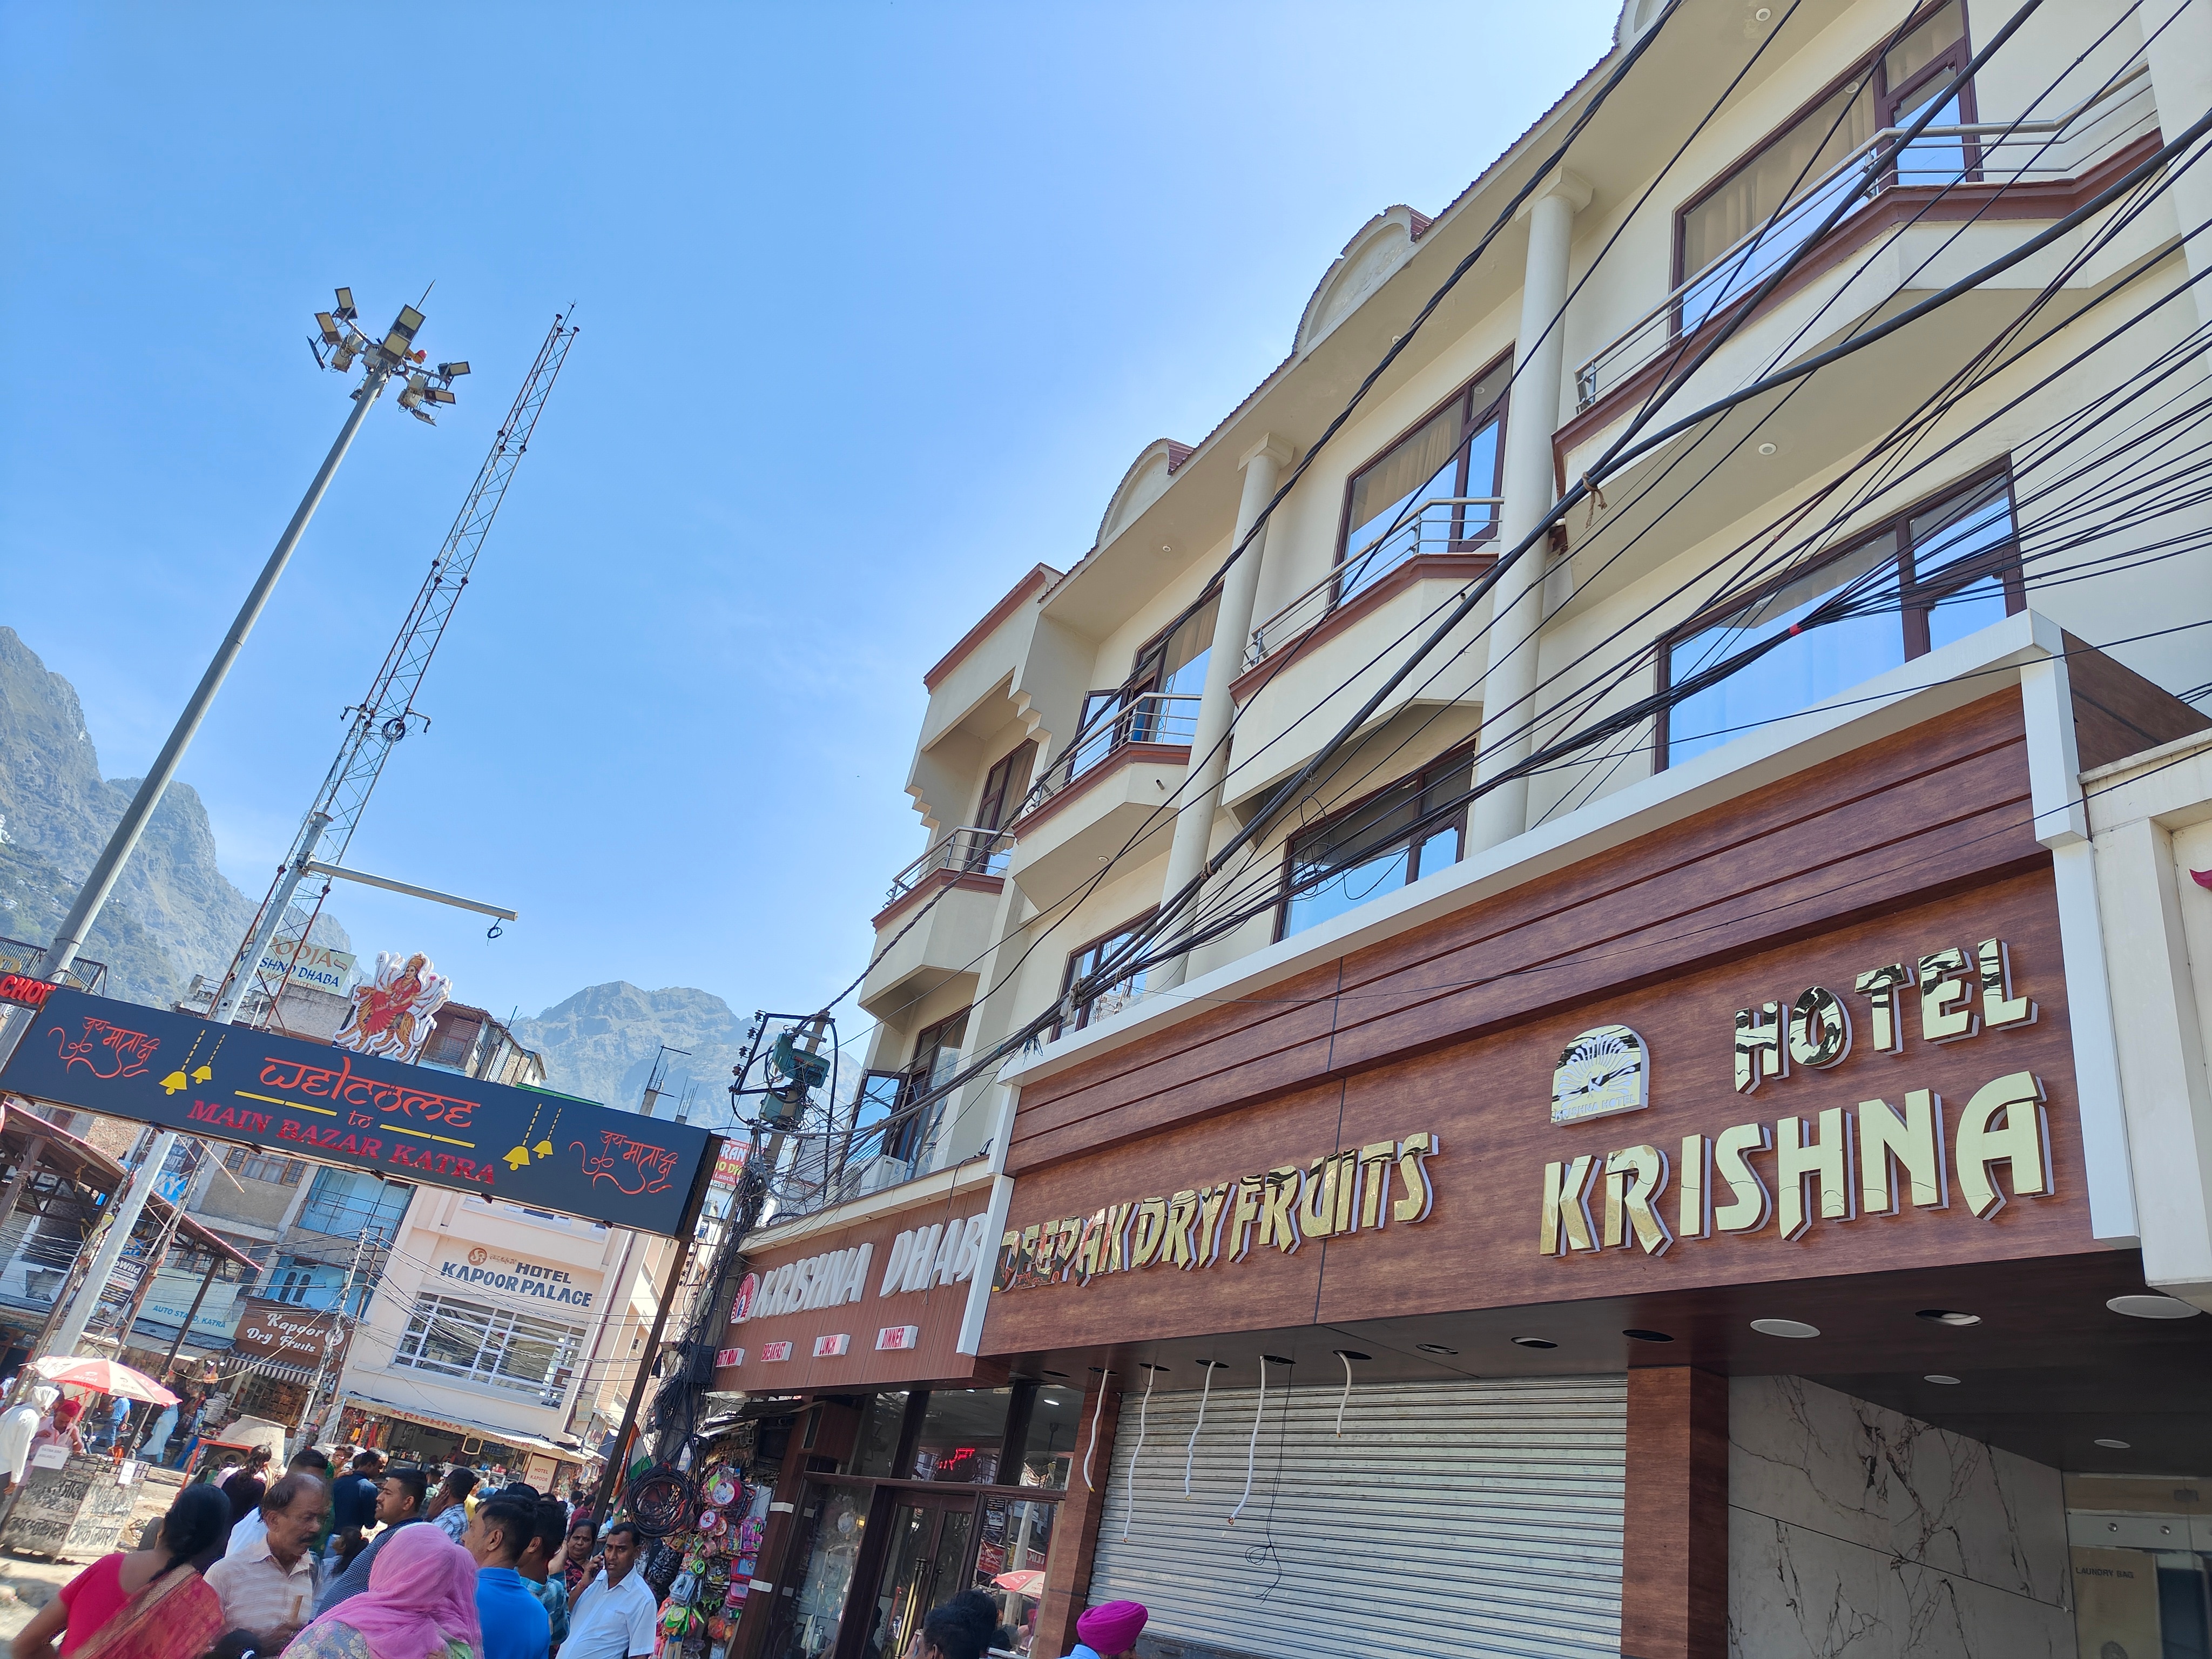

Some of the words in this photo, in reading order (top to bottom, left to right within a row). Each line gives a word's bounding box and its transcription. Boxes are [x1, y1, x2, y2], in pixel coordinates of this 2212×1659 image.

[298, 967, 339, 987] DHABA
[1735, 938, 2038, 1093] HOTEL
[1555, 1102, 1599, 1121] KRISHNA
[1601, 1094, 1636, 1109] HOTEL
[348, 1110, 374, 1129] to
[187, 1100, 273, 1134] MAIN
[276, 1119, 382, 1159] BAZAR
[388, 1144, 495, 1185] KATRA
[1540, 1071, 2054, 1256] KRISHNA
[992, 1202, 1138, 1287] DEEPAK
[1131, 1182, 1235, 1271] DRY
[1229, 1132, 1438, 1264] FRUITS
[114, 1260, 142, 1274] oWild
[515, 1262, 571, 1284] HOTEL
[440, 1262, 519, 1292] KAPOOR
[520, 1279, 592, 1307] PALACE
[751, 1243, 874, 1319] KRISHNA
[153, 1305, 173, 1314] AUTO
[174, 1311, 199, 1323] STAD,
[201, 1317, 226, 1328] KATRA
[267, 1313, 325, 1337] Kapoor
[247, 1328, 273, 1345] Dry
[280, 1335, 316, 1352] Fruits
[819, 1336, 837, 1355] LUNCH
[881, 1327, 905, 1348] DINNER
[761, 1343, 786, 1360] BREAKFAST
[391, 1409, 462, 1431] KRISHNA
[2075, 1567, 2114, 1577] LAUNDRY
